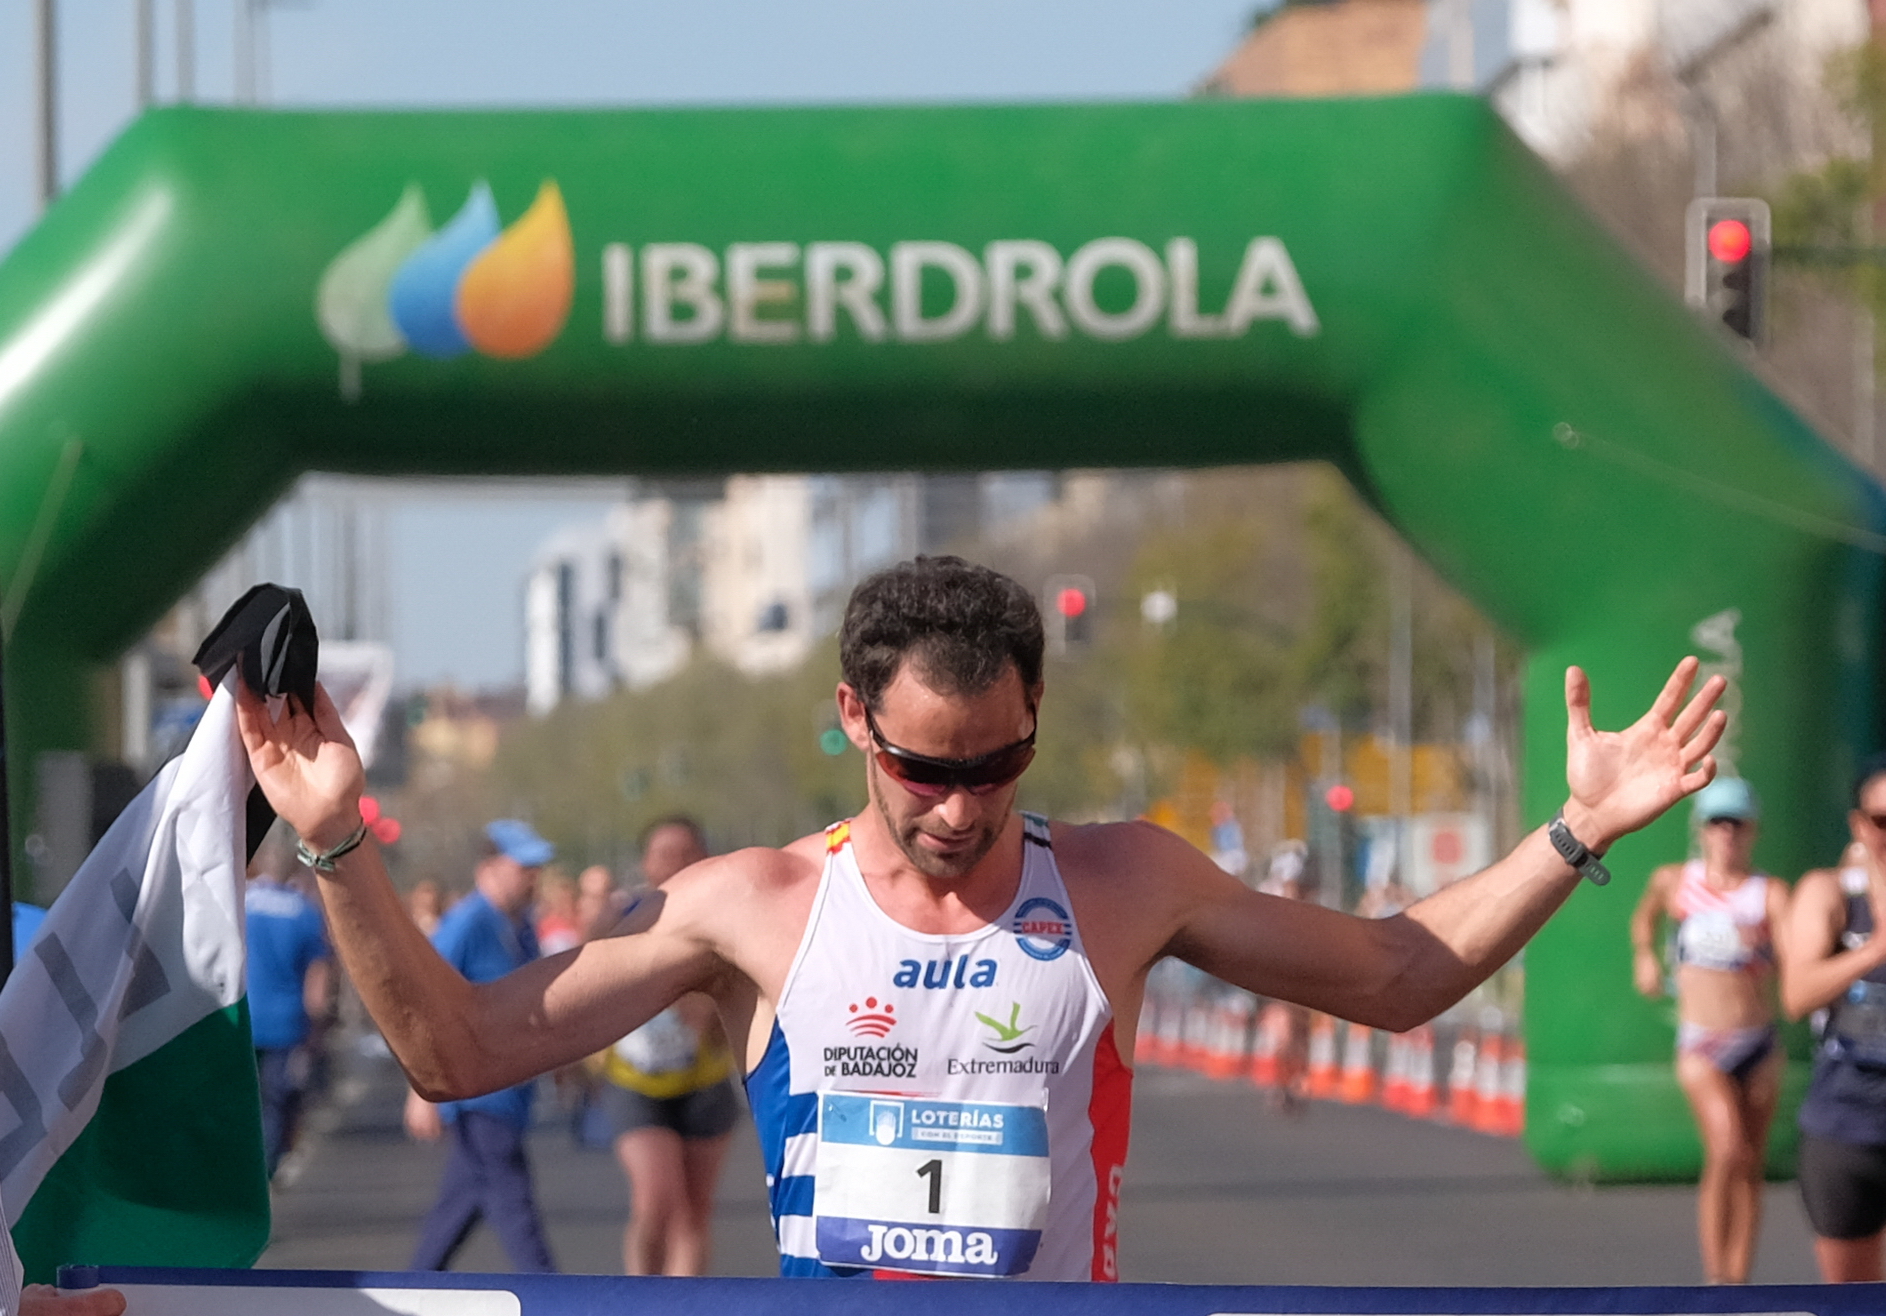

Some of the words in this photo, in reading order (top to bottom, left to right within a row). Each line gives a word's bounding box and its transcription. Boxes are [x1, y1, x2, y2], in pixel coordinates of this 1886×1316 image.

[601, 235, 1319, 344] IBERDROLA
[893, 954, 997, 989] aula
[823, 1043, 918, 1063] DIPUTACIÓN
[947, 1057, 1060, 1075] Extremadura
[841, 1062, 917, 1078] BADAJOZ
[911, 1109, 1005, 1129] LOTERÍAS
[917, 1159, 942, 1214] 1
[860, 1224, 999, 1265] Joma
